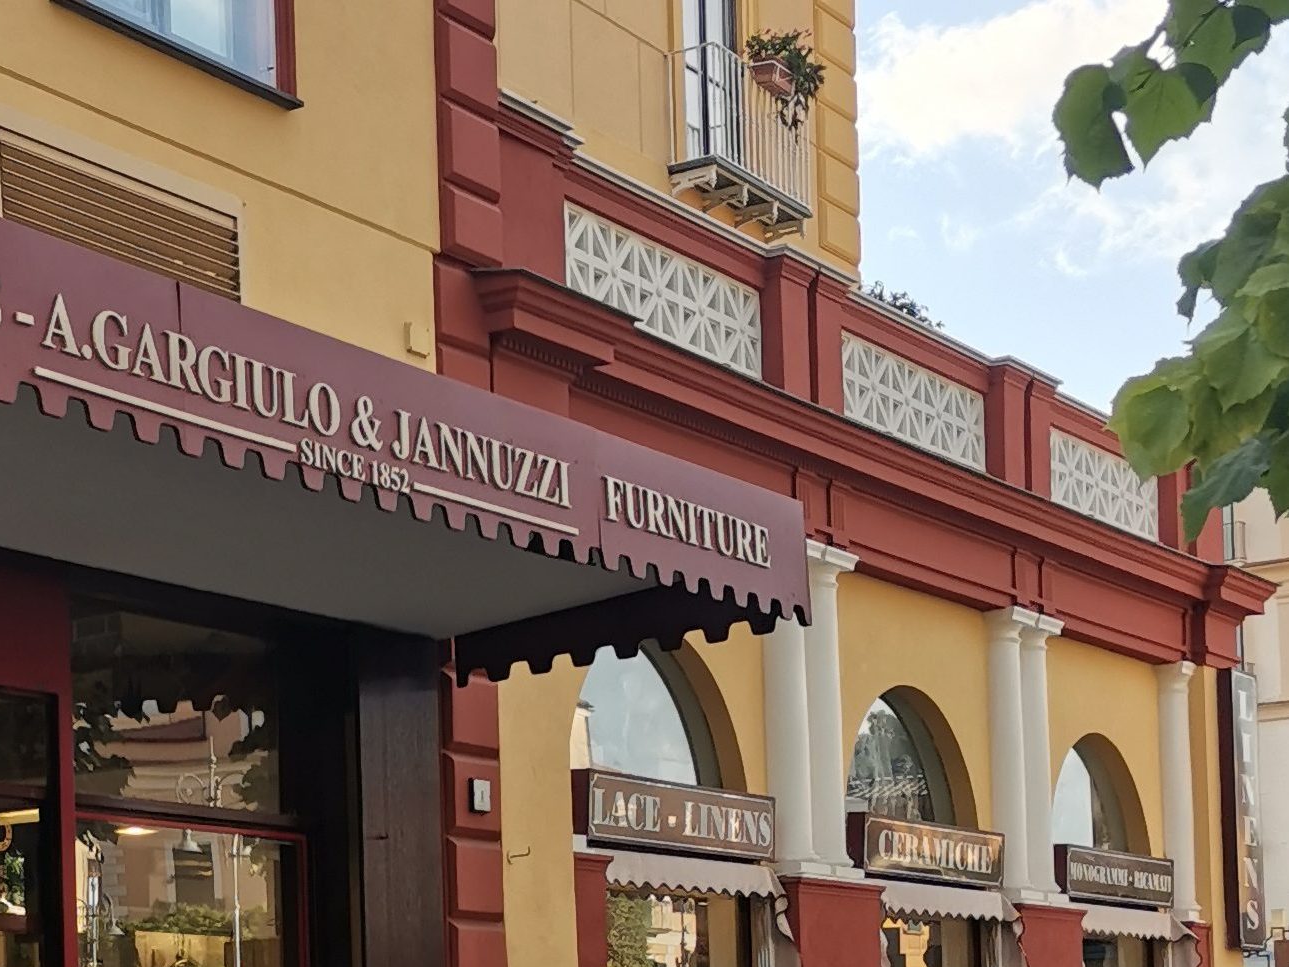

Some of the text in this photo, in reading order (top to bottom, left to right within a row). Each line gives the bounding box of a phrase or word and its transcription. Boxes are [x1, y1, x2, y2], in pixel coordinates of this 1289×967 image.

[41, 293, 341, 436] A.GARGIULO
[350, 395, 383, 452] &
[391, 408, 572, 509] JANNUZZI
[601, 474, 771, 569] FURNITURE
[300, 438, 411, 494] SINCE 1852
[592, 787, 660, 832] LACE
[682, 801, 772, 847] LINENS
[1238, 690, 1260, 931] LINENS
[878, 829, 993, 874] CERAMICHE
